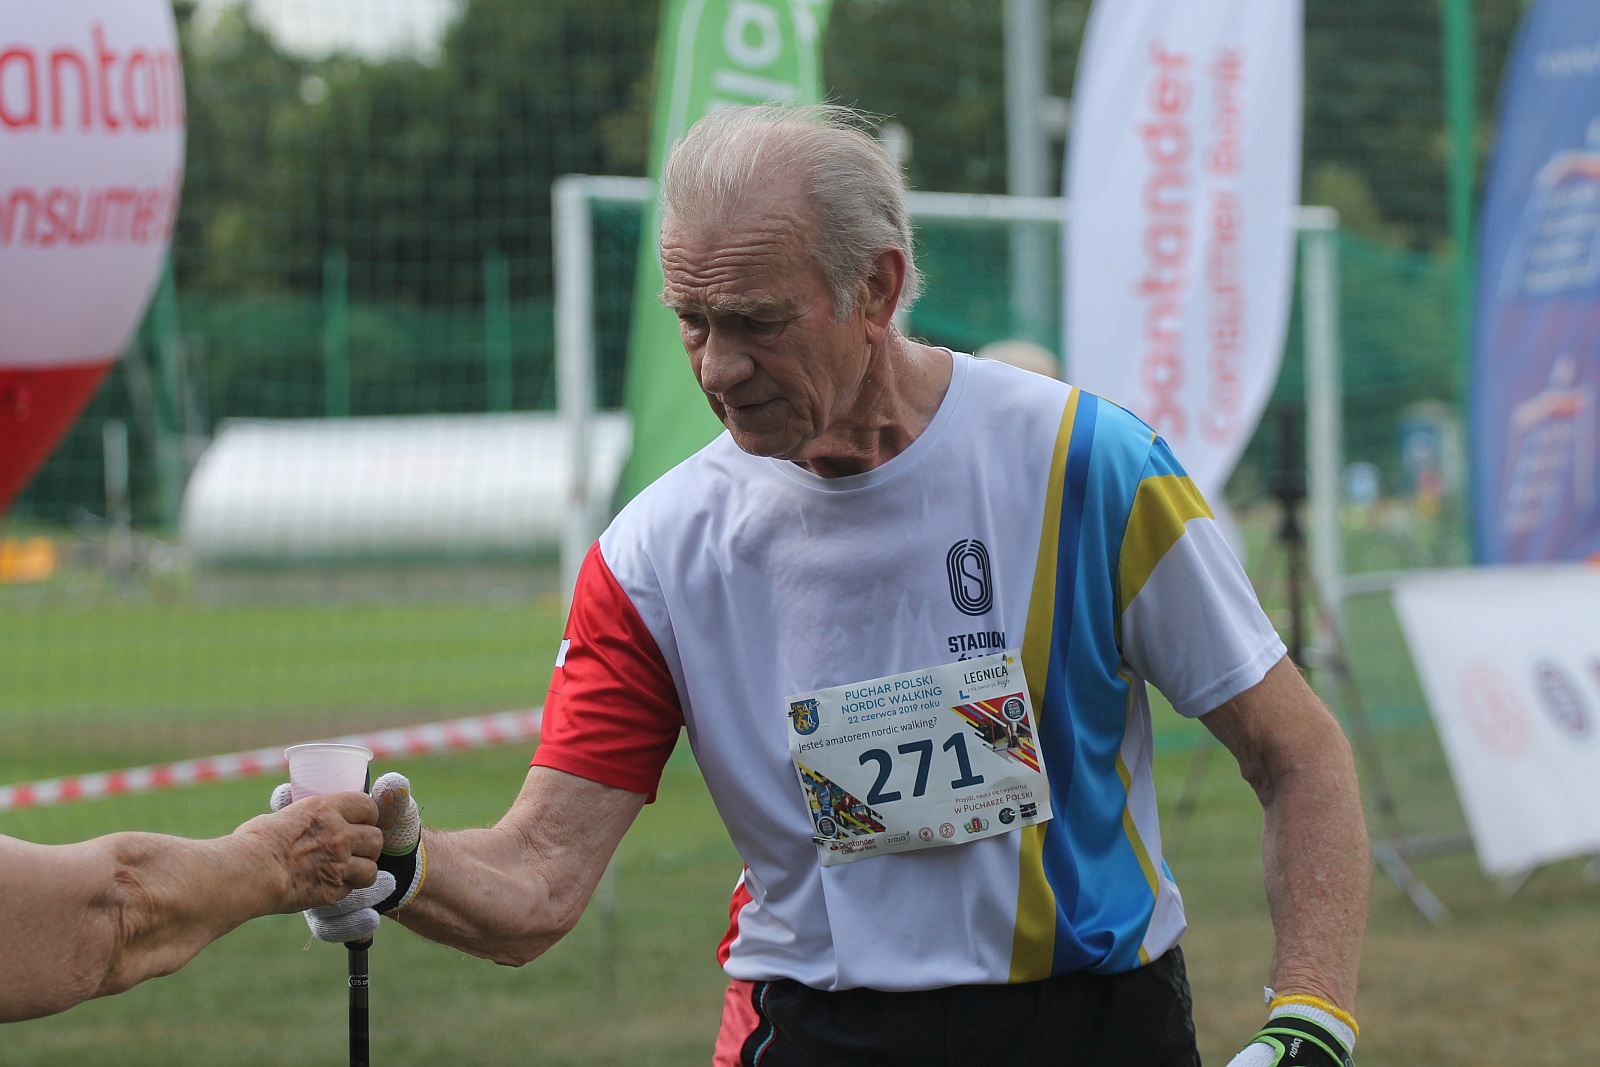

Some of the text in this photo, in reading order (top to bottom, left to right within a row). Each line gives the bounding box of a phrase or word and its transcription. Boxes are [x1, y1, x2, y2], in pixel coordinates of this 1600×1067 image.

[948, 631, 1006, 653] STADION
[845, 675, 934, 701] PUCHAR POLSKI
[963, 666, 1009, 685] LEGNICA
[841, 686, 943, 715] NORDIC WALKING
[848, 700, 941, 724] 22 czerwca 2019 roku
[798, 716, 938, 753] Jesteś amatorem nordic walking?
[859, 732, 985, 806] 271
[963, 797, 1005, 812] PUCHARZE
[1006, 791, 1033, 802] POLSKI
